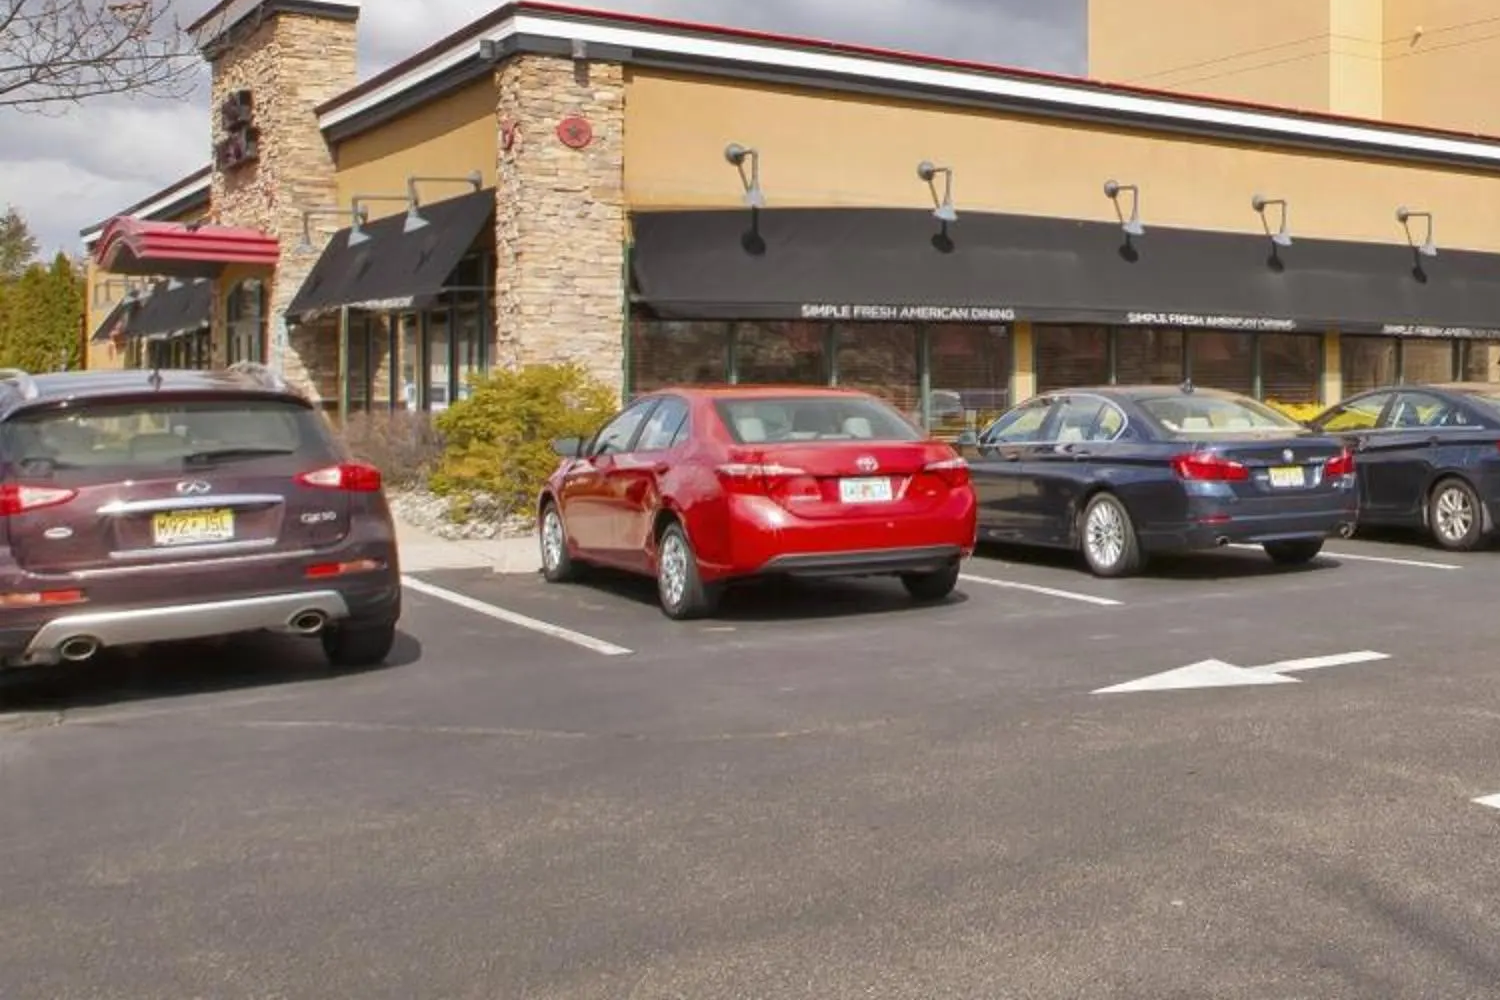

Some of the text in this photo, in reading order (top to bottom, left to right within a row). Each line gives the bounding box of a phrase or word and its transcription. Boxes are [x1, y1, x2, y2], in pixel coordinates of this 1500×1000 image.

[801, 304, 1016, 321] SIMPLE FRESH AMERICAN DINING
